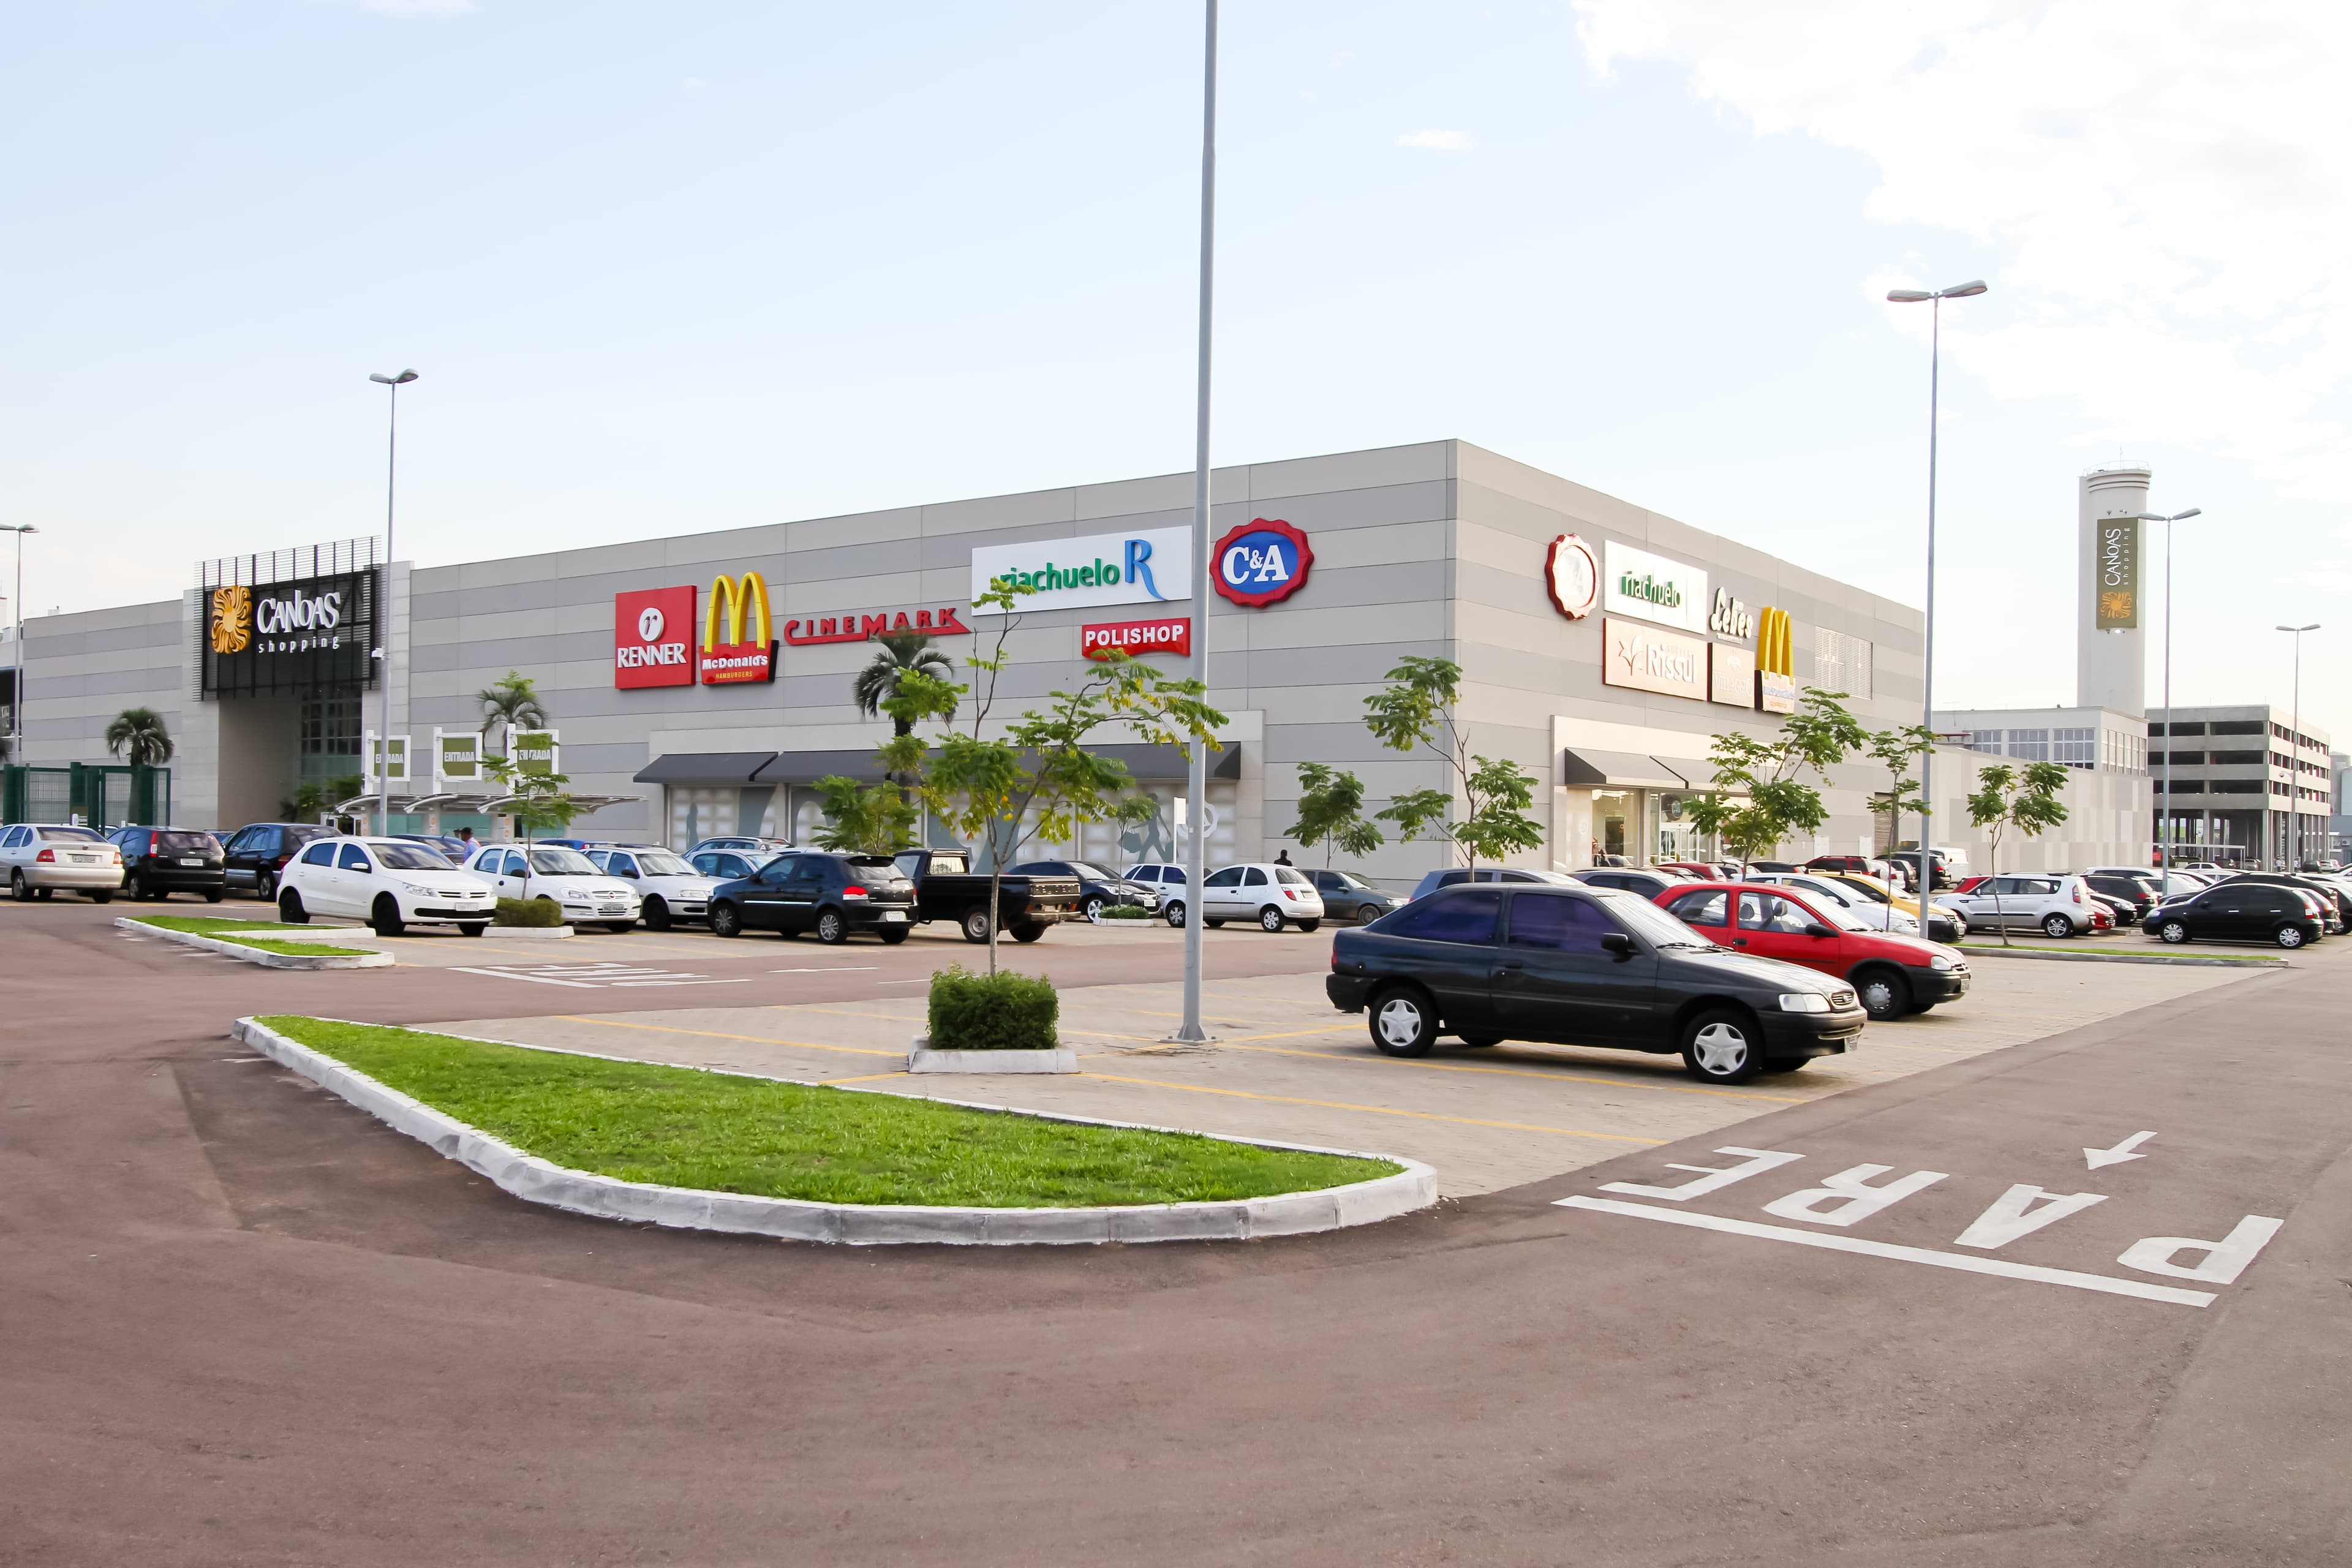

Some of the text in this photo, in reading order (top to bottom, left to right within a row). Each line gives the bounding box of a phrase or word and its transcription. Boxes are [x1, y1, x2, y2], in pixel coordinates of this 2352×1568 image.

[1223, 545, 1289, 584] C&A
[2101, 528, 2121, 586] CANOAS
[1621, 570, 1681, 608] riachuelo
[257, 589, 341, 633] CANOAS
[784, 608, 970, 646] CINEMARK
[1708, 587, 1754, 639] Lebes
[258, 636, 340, 654] shopping
[1085, 625, 1184, 647] POLISHOP
[617, 643, 687, 668] RENNER
[702, 655, 768, 670] McDonald's
[1646, 644, 1697, 684] Rissul
[715, 671, 753, 679] HAMBURGERS
[375, 753, 404, 764] ERADA
[444, 752, 475, 762] ENTRADA
[1597, 1147, 2284, 1284] PARE
